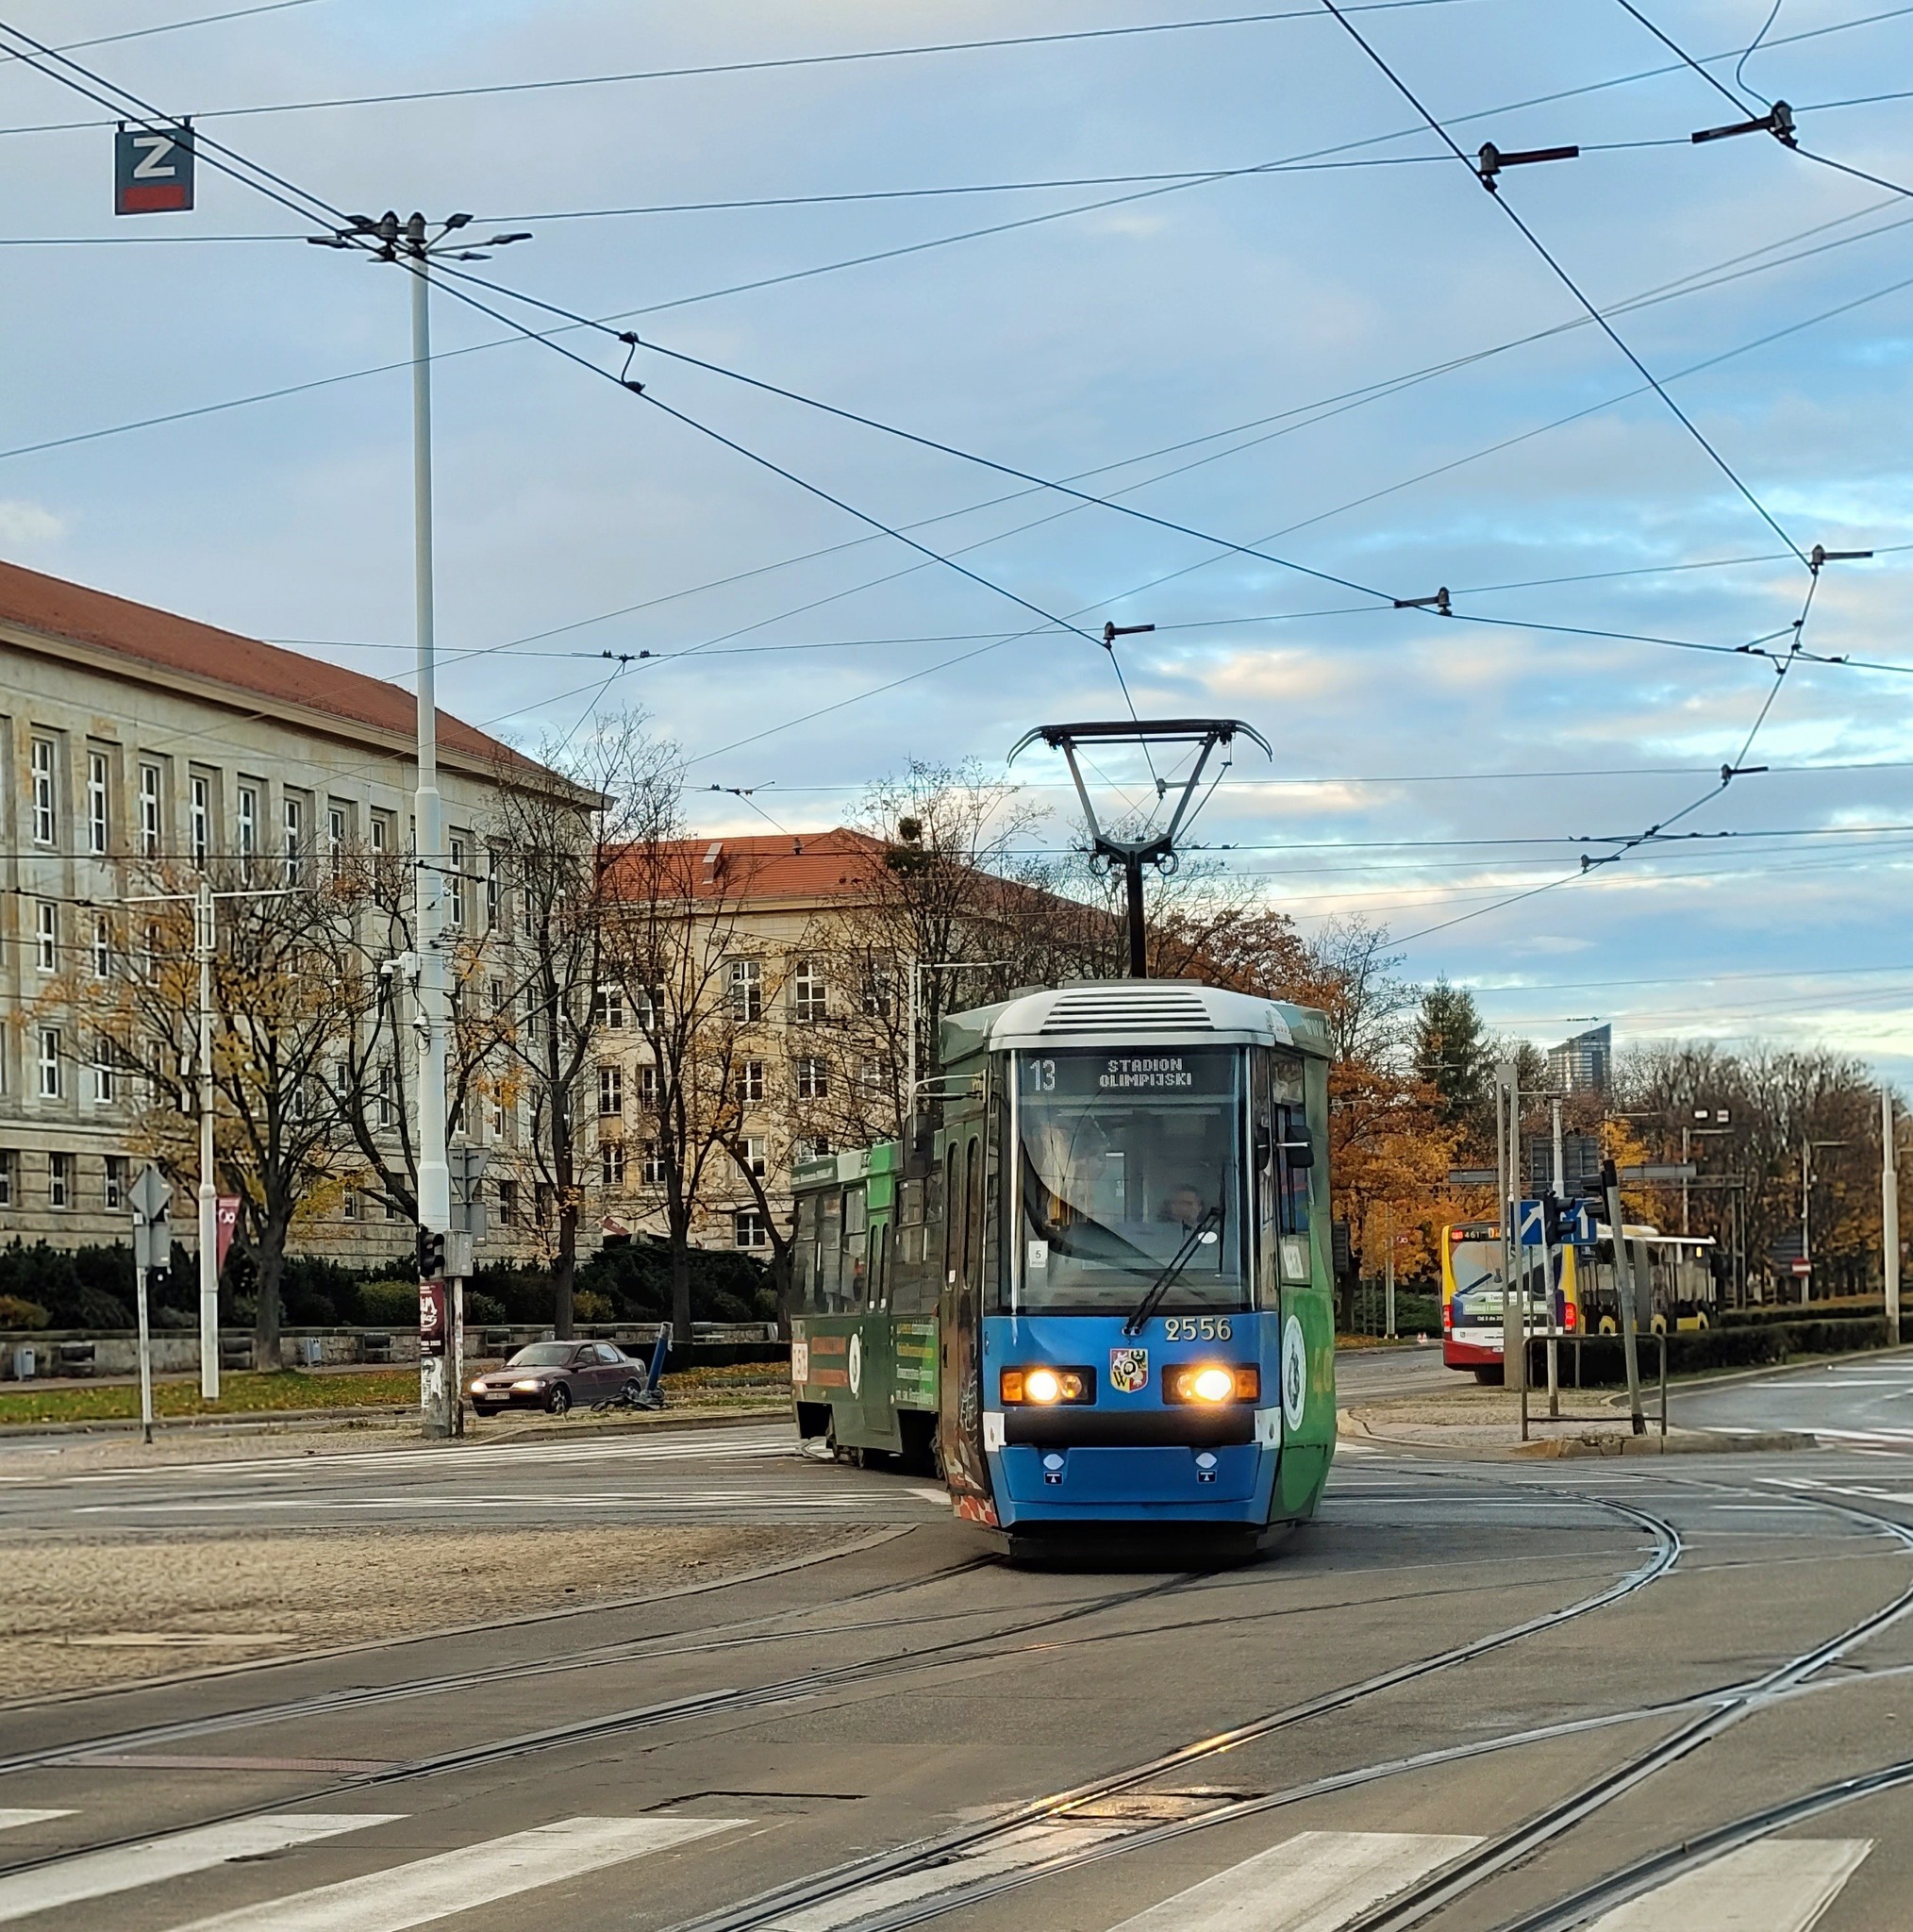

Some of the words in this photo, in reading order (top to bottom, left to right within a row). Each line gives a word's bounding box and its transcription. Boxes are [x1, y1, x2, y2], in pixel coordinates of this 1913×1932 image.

[133, 135, 175, 178] Z
[1030, 1059, 1056, 1091] 13
[1107, 1058, 1183, 1073] STADION
[1099, 1073, 1192, 1087] OLIMPIJSKI
[1035, 1250, 1041, 1259] 5
[1165, 1317, 1233, 1341] 2556
